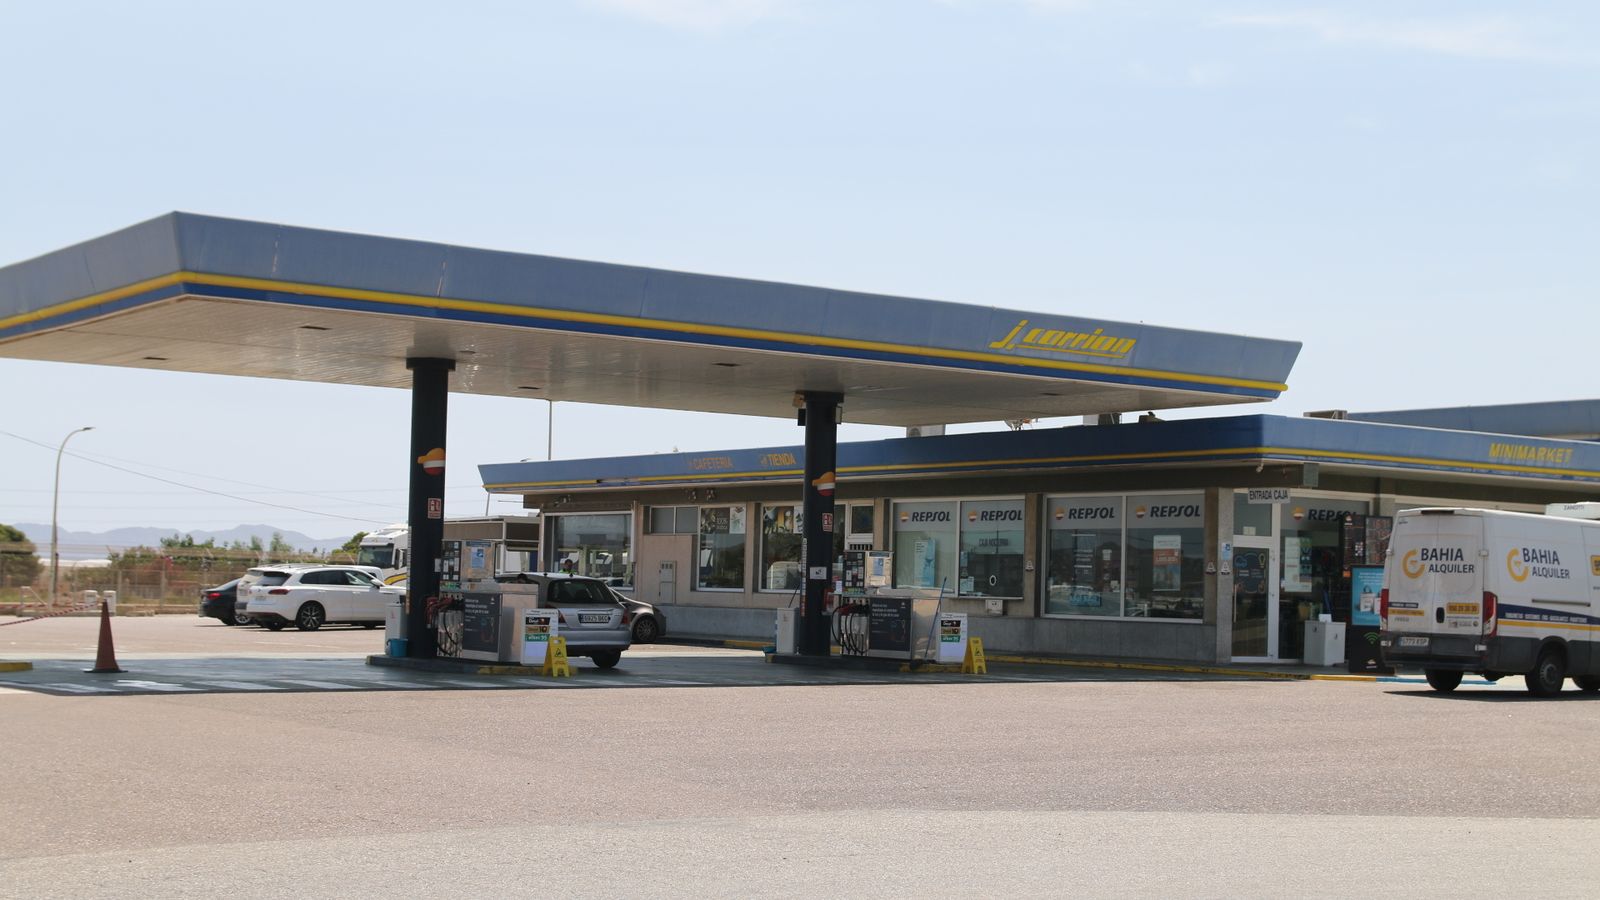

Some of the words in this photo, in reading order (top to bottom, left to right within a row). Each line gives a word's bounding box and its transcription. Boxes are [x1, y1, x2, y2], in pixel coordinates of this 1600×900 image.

[767, 453, 797, 467] TIENDA
[1489, 442, 1574, 464] MINIMARKET
[1249, 490, 1273, 500] ENTRADA
[1274, 489, 1289, 500] CAJA
[911, 511, 952, 522] REPSOL
[980, 510, 1023, 521] REPSOL
[1068, 507, 1115, 520] REPSOL
[1149, 504, 1201, 518] REPSOL
[1420, 547, 1464, 561] BAHIA
[1522, 547, 1561, 565] BAHIA
[1428, 564, 1475, 574] ALQUILER
[1532, 566, 1570, 580] ALQUILER
